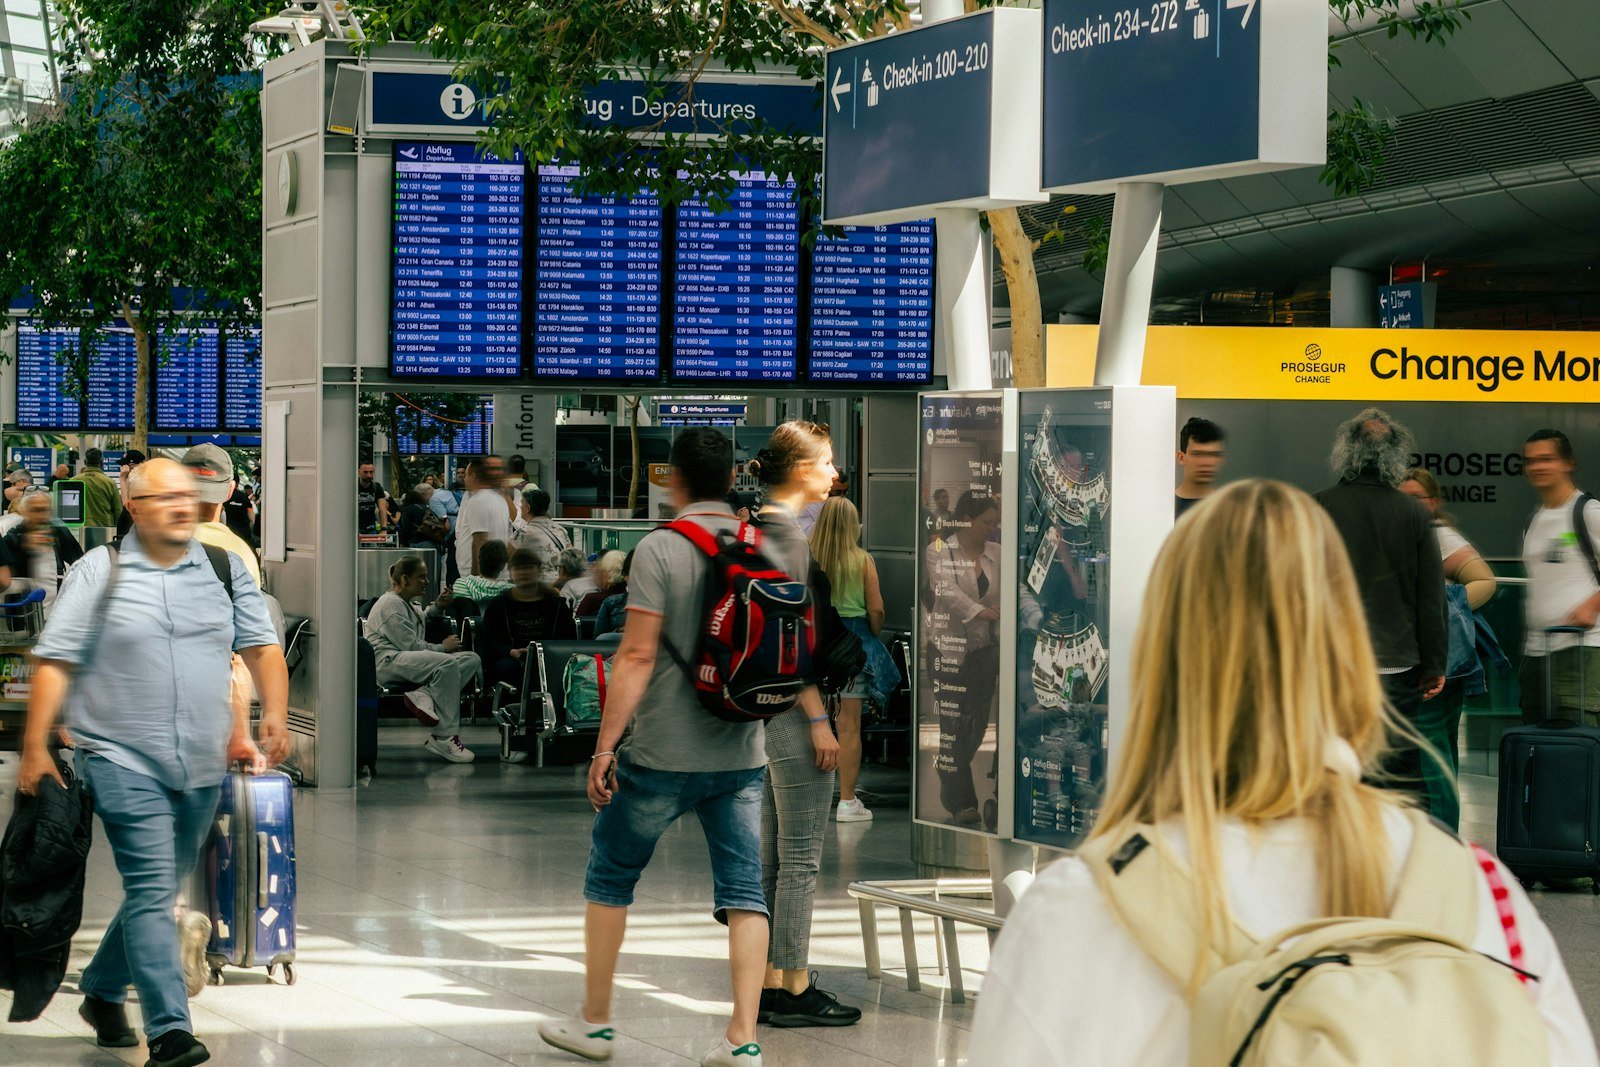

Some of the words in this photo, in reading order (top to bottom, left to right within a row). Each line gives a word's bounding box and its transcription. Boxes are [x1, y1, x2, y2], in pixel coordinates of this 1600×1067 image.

[1051, 14, 1110, 54] Check-in
[883, 55, 933, 91] Check-in
[935, 42, 988, 79] 100–210
[632, 95, 756, 126] Departures
[426, 146, 452, 156] Abflug
[426, 155, 455, 163] Departures
[1281, 362, 1346, 374] PROSEGUR
[1369, 347, 1525, 392] Change
[1295, 375, 1331, 384] CHANGE
[1409, 452, 1523, 477] PROSEG
[1438, 485, 1497, 503] ANGE
